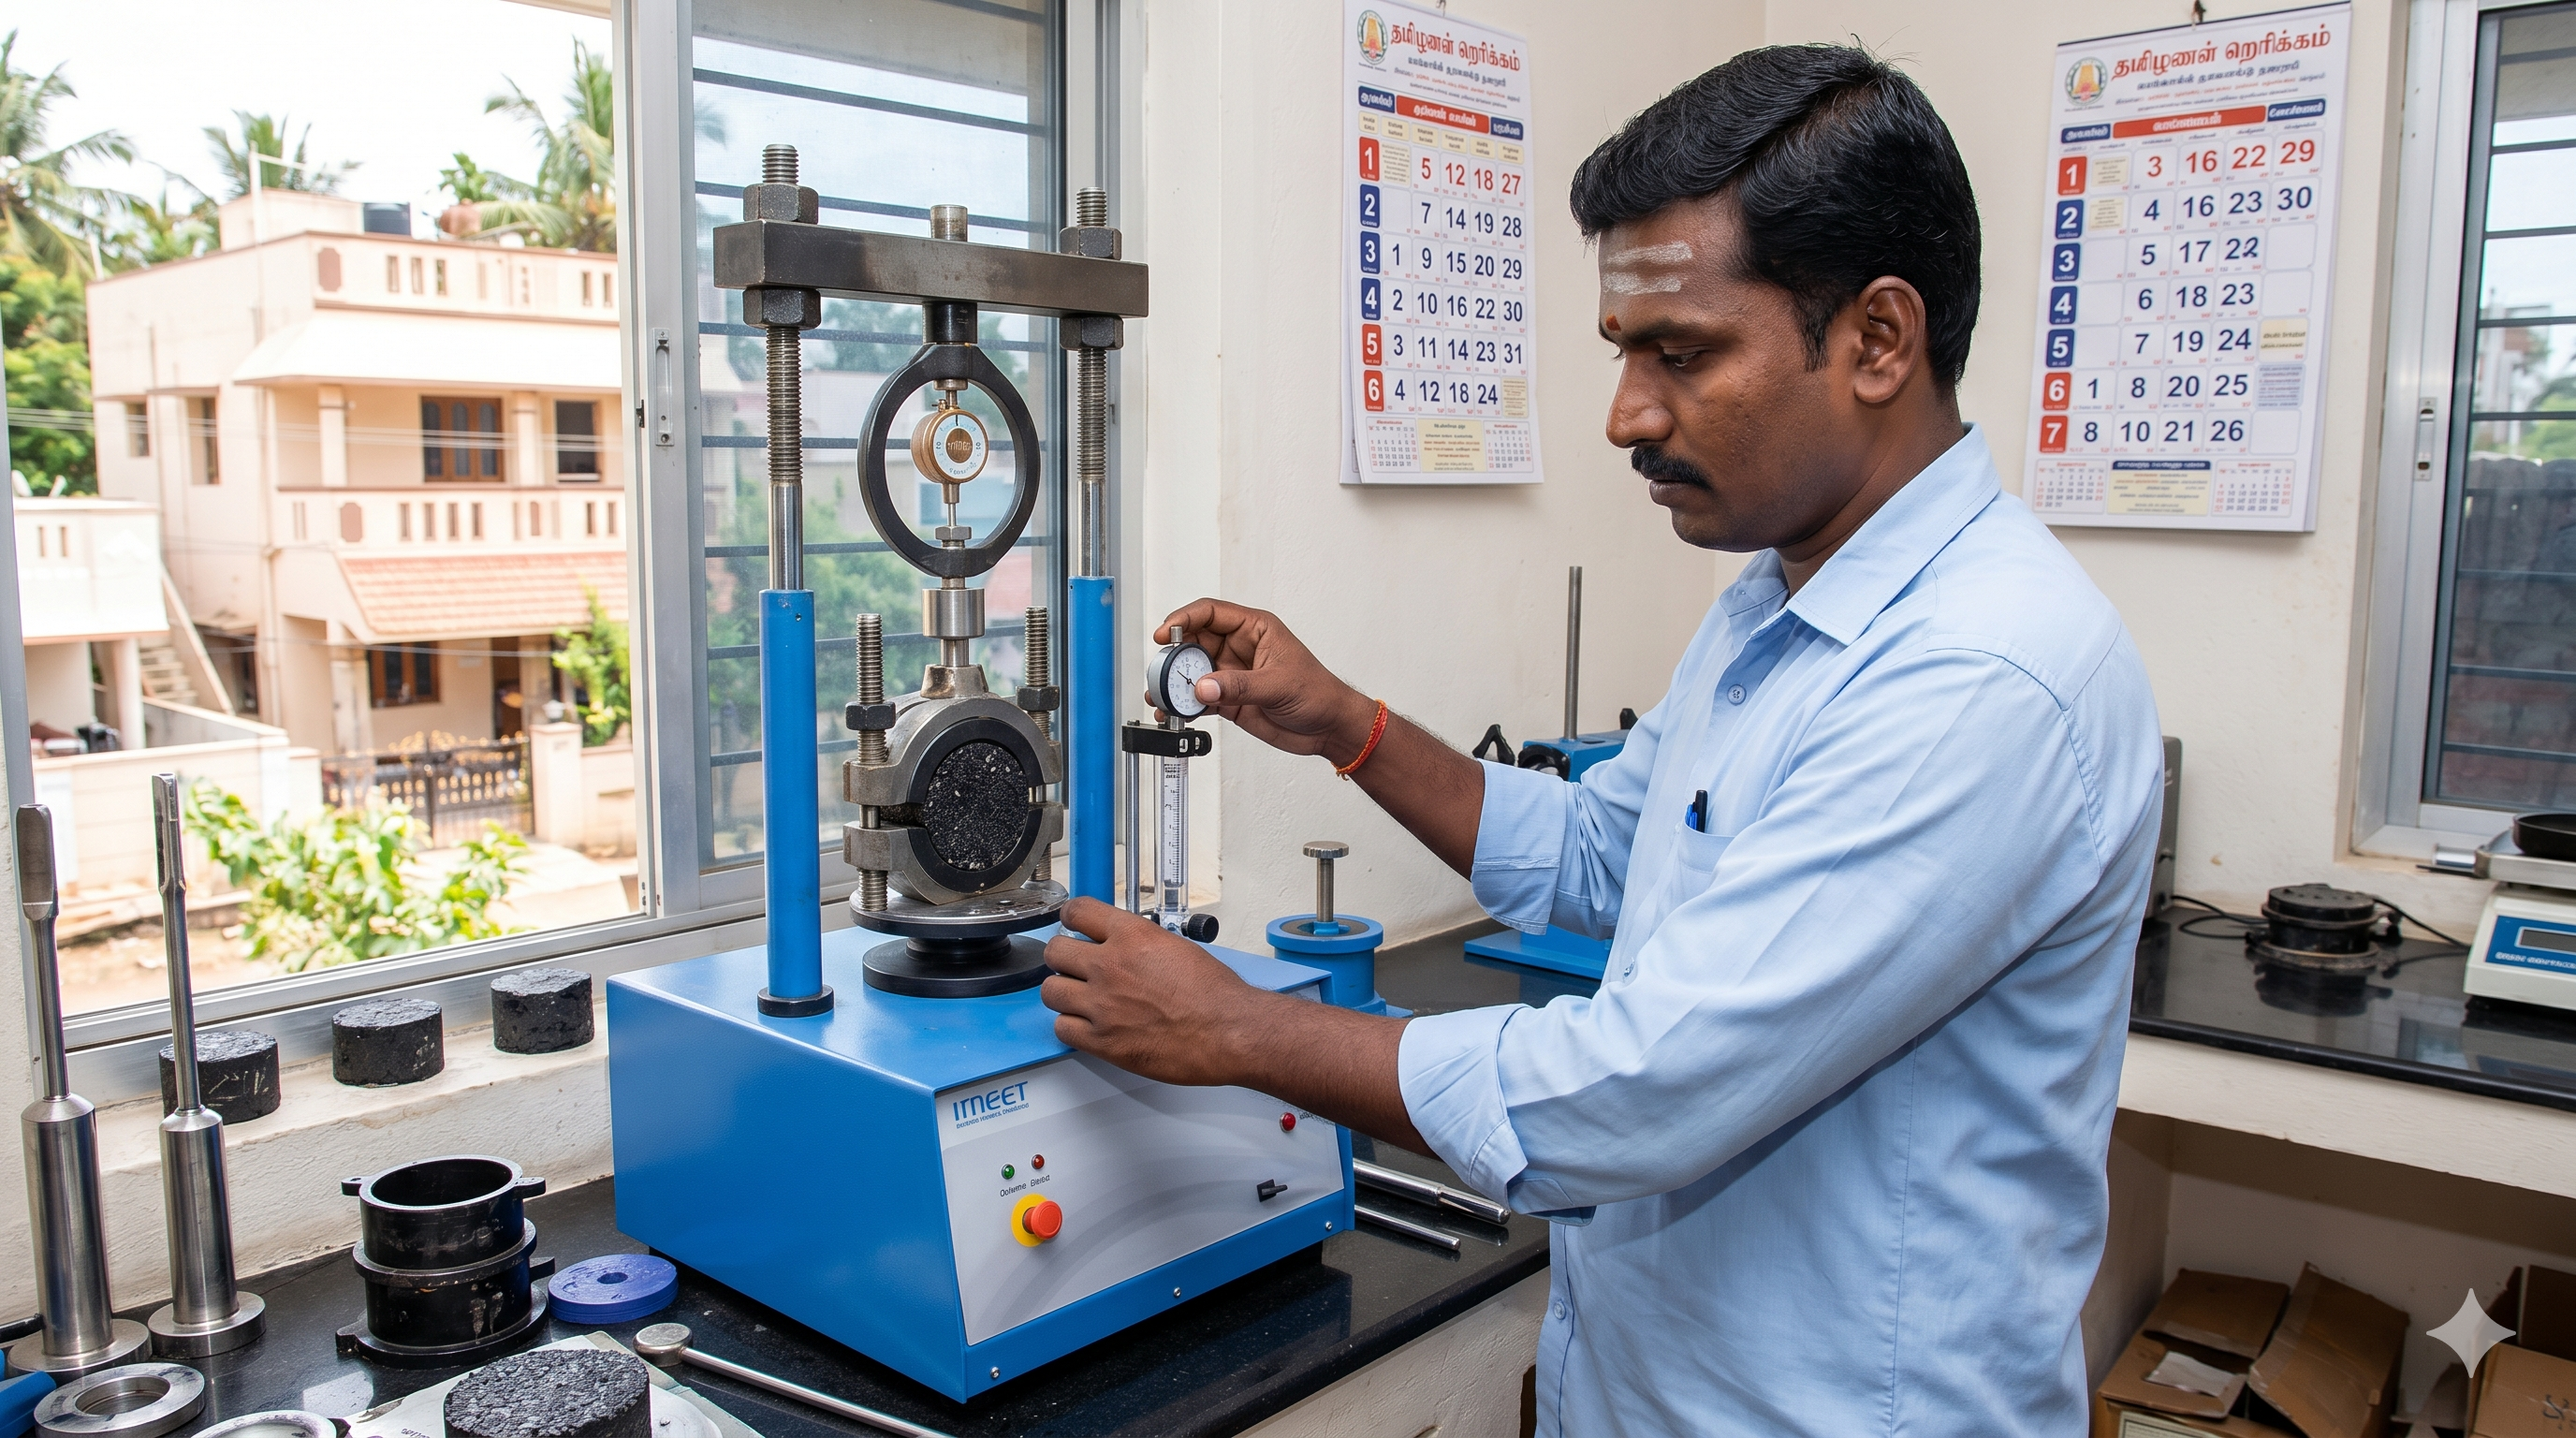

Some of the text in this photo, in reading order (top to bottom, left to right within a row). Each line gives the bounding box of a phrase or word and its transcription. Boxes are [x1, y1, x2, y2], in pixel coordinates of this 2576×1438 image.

[1365, 147, 1372, 170] 1
[1421, 157, 1431, 180] 5
[1445, 162, 1466, 186] 12
[1474, 168, 1494, 191] 18
[1501, 172, 1521, 196] 27
[2066, 164, 2077, 186] 1
[2147, 155, 2162, 178] 3
[2186, 150, 2217, 173] 16
[2232, 144, 2266, 169] 22
[2280, 139, 2315, 165] 29
[1365, 193, 1522, 239] 2 7 14 19 28
[2061, 207, 2078, 229] 2
[2144, 199, 2159, 221] 4
[2183, 195, 2215, 218] 16
[2228, 190, 2262, 214] 23
[2277, 186, 2312, 211] 30
[1365, 240, 1522, 280] 3 1 9 15 20 29
[2058, 250, 2074, 272] 3
[2141, 243, 2156, 266] 5
[2179, 240, 2211, 263] 17
[1365, 286, 1523, 322] 4 2 10 16 22 30
[2055, 283, 2254, 315] 4 6 18 23
[1367, 332, 1522, 364] 5 3 11 14 23 31
[2053, 336, 2069, 359] 5
[2135, 333, 2149, 355] 7
[2173, 330, 2203, 353] 19
[2217, 328, 2252, 351] 24
[1368, 378, 1380, 402] 6
[1395, 378, 1406, 401] 4
[1419, 380, 1441, 403] 12
[1449, 381, 1470, 404] 18
[1477, 383, 1499, 405] 24
[2049, 379, 2065, 402] 6
[2087, 378, 2098, 399] 1
[2130, 376, 2145, 399] 8
[2167, 375, 2200, 398] 20
[2214, 374, 2248, 397] 25
[2046, 419, 2244, 444] 7 8 10 21 26
